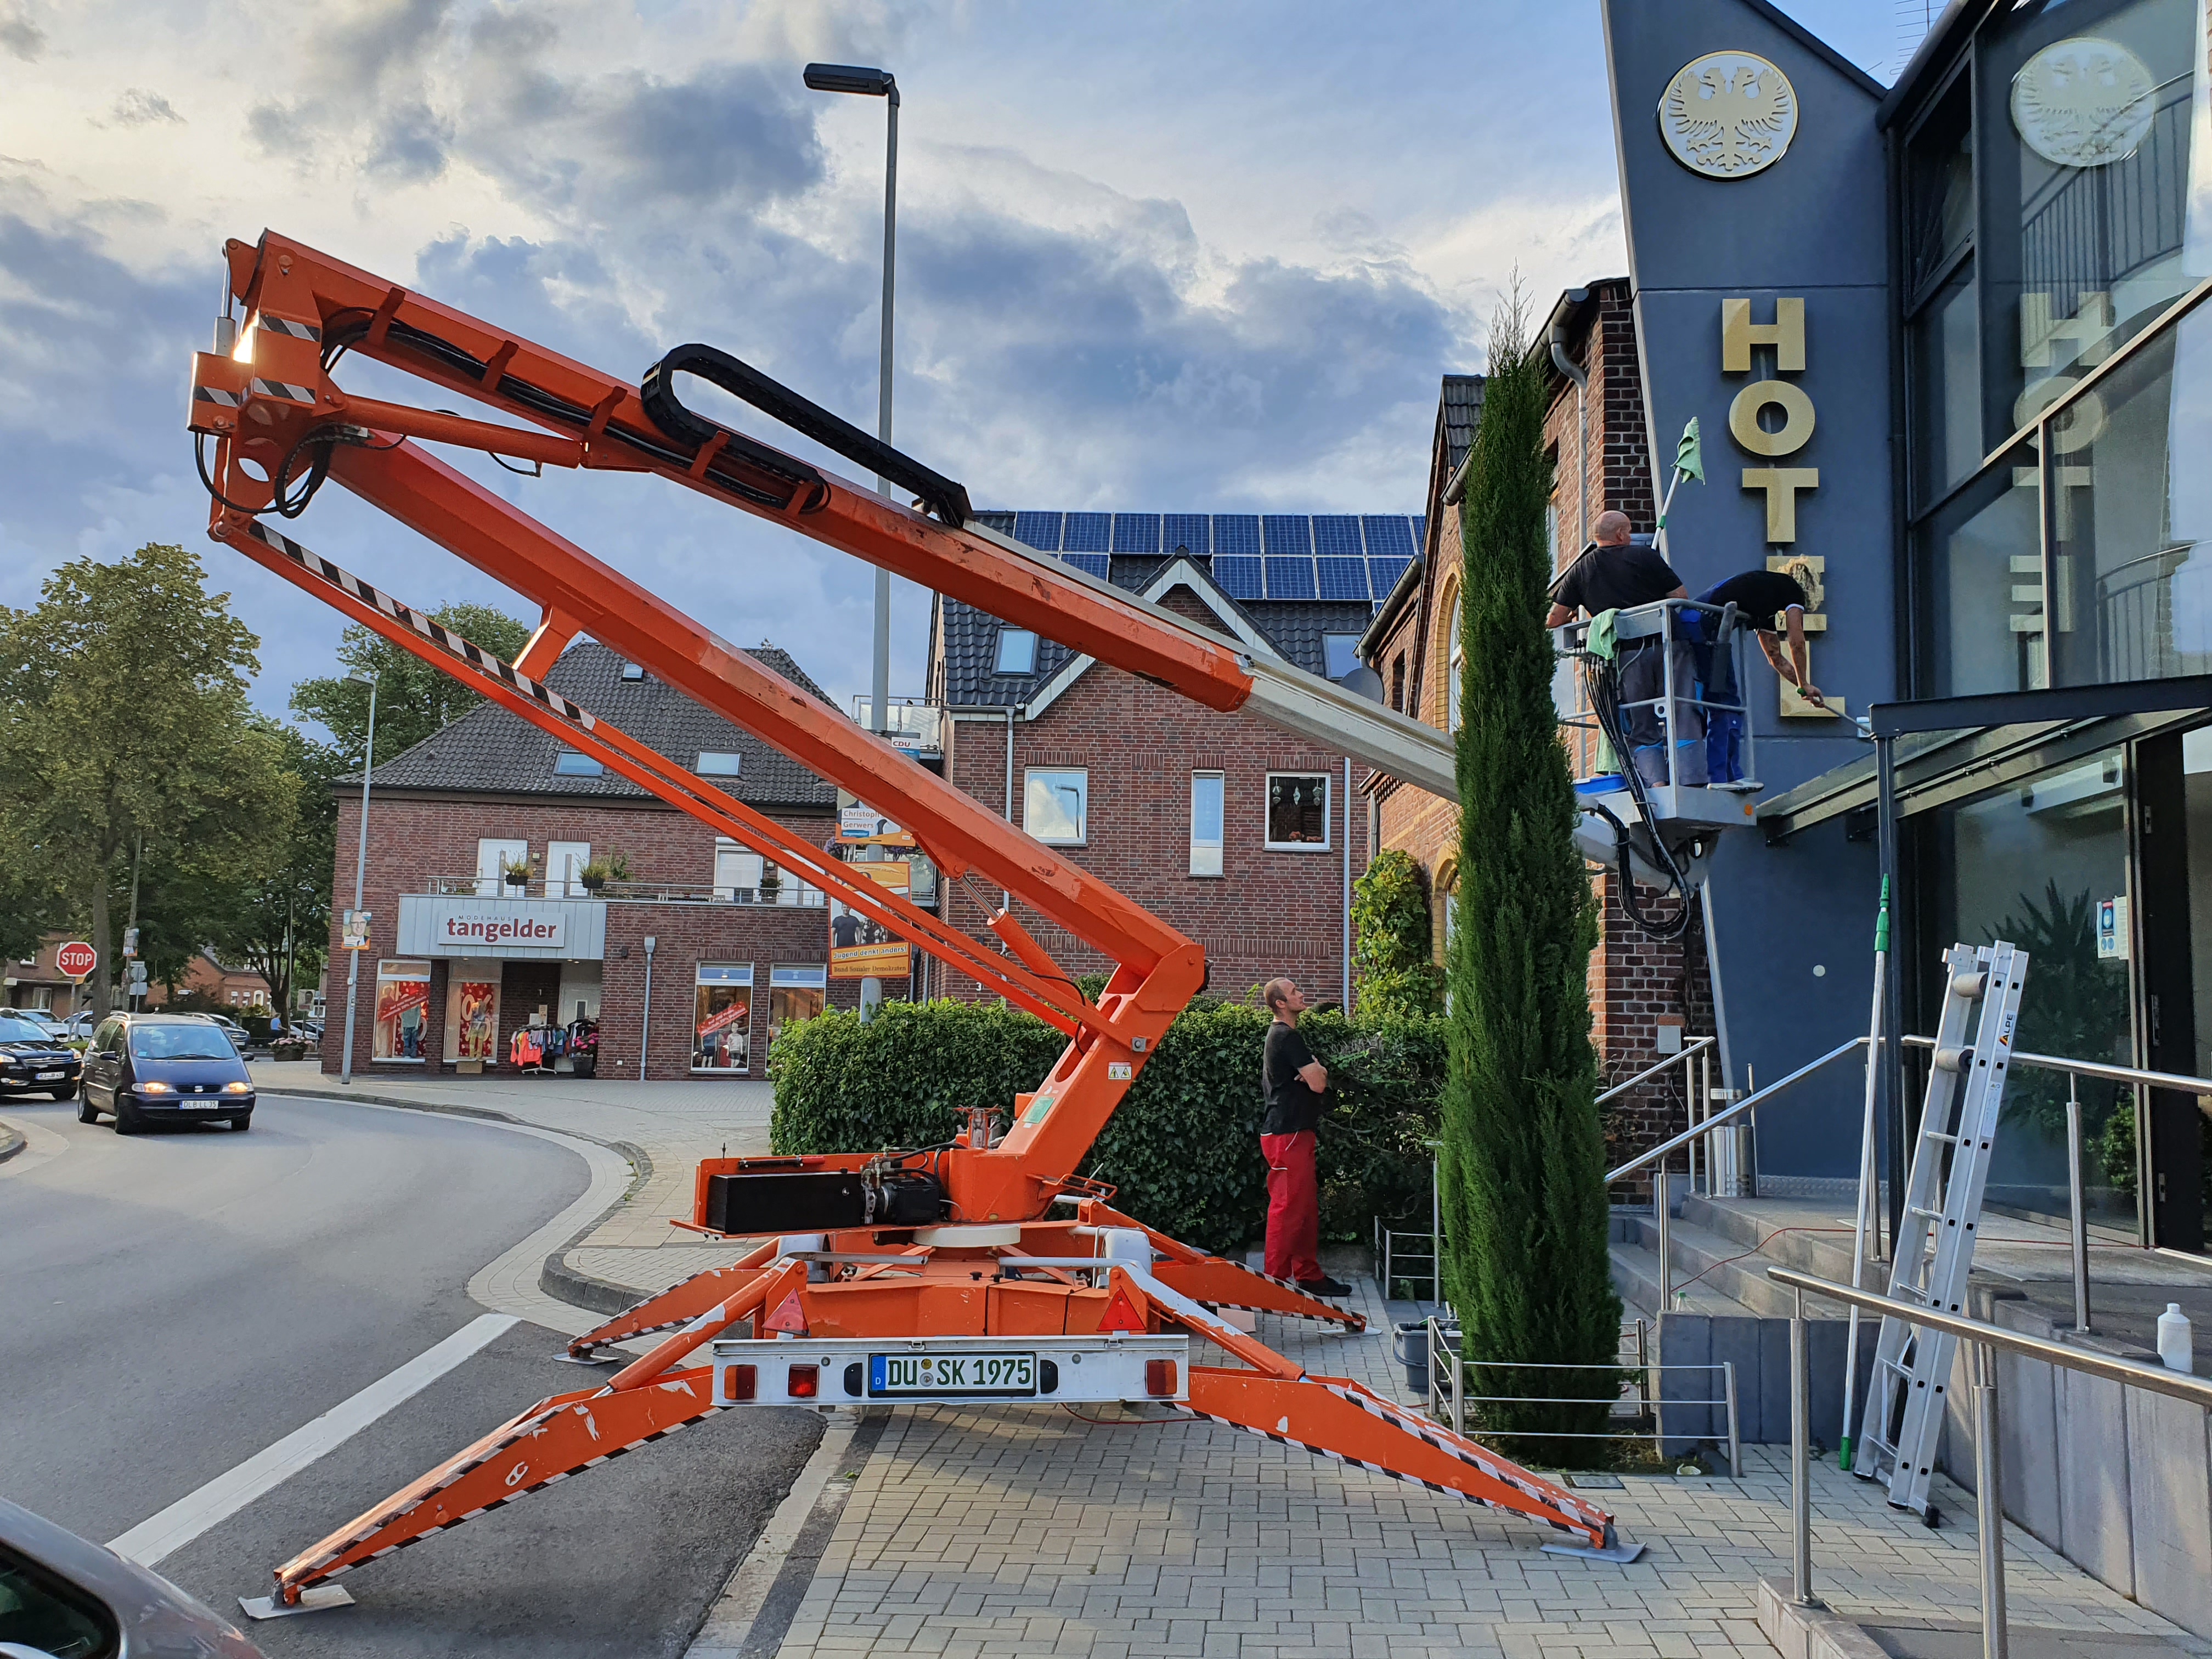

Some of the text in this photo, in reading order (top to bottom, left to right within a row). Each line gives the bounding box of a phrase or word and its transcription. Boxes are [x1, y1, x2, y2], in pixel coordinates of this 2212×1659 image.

[447, 918, 557, 943] tangelder
[61, 952, 93, 966] STOP
[833, 950, 858, 959] Jugend
[976, 982, 981, 991] 3
[1999, 1013, 2013, 1047] ALPE
[888, 1360, 917, 1385] DU
[937, 1359, 966, 1385] SK
[973, 1359, 1031, 1385] 1975
